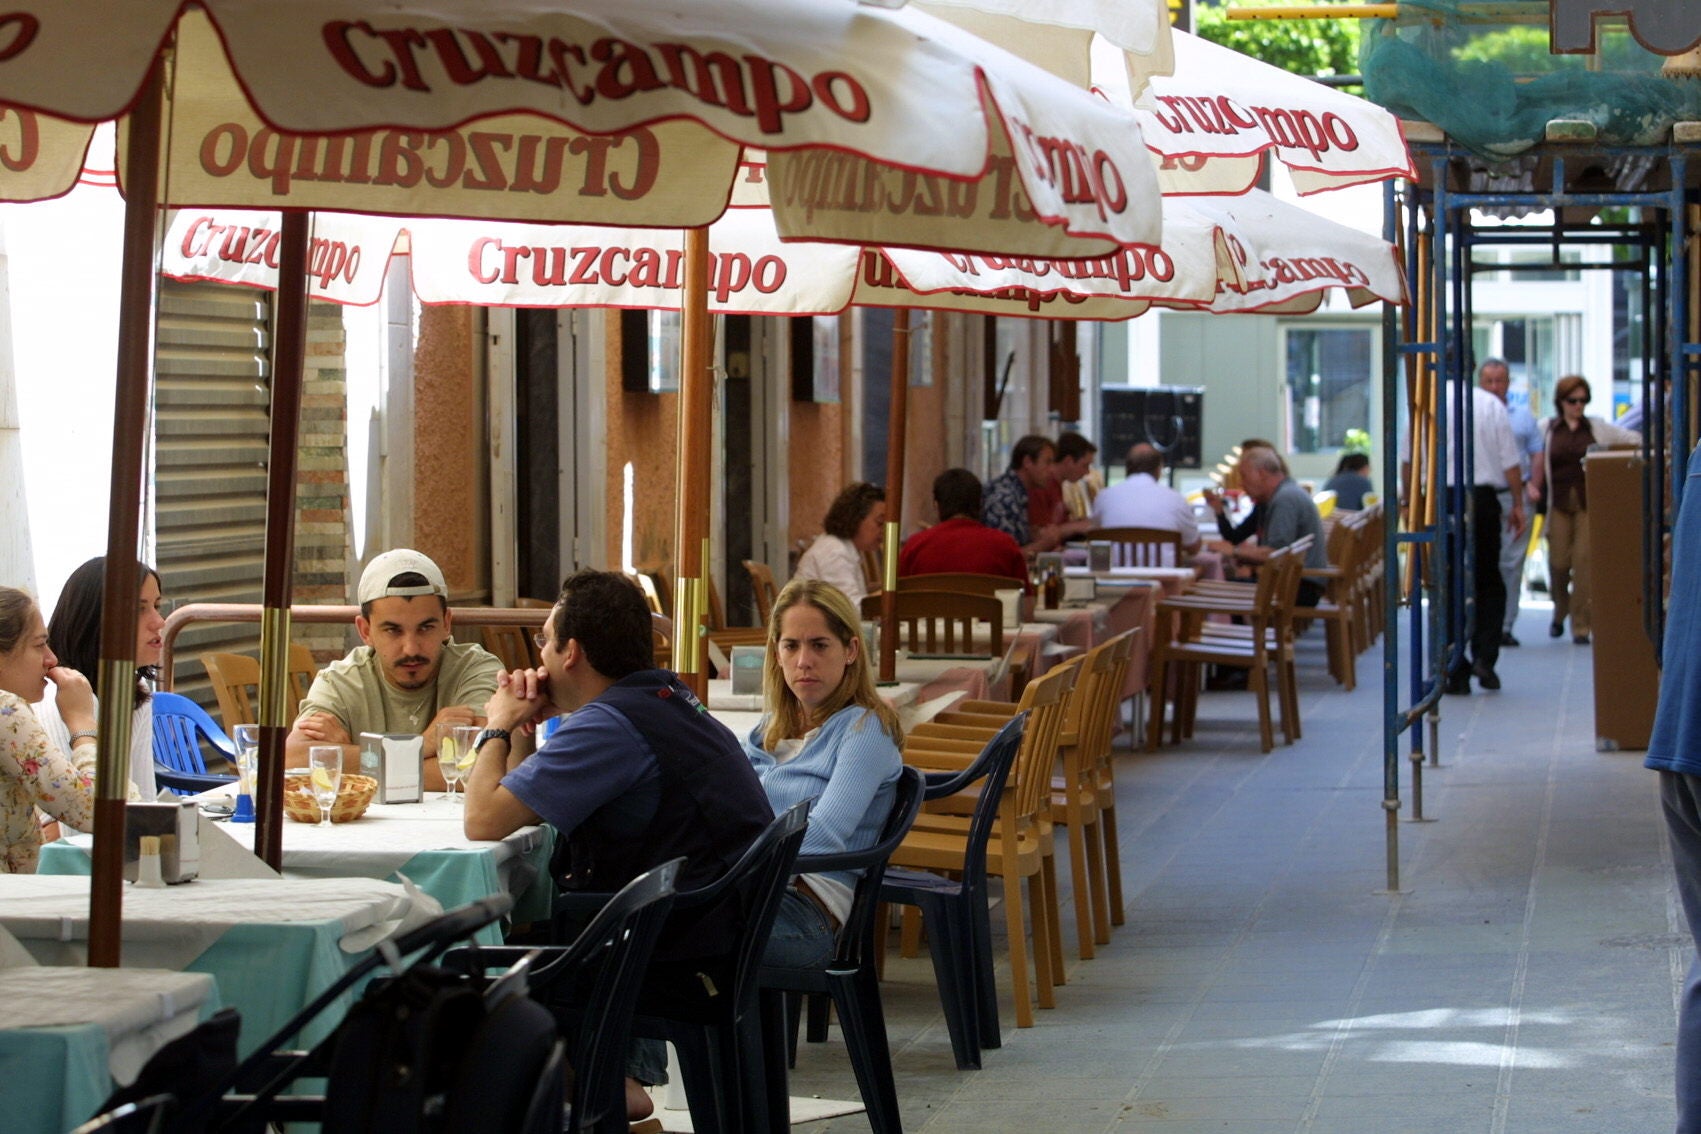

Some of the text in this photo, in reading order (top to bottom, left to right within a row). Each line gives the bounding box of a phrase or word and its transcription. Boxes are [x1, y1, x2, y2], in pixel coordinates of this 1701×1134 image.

[322, 20, 870, 135] Cruzcampo
[180, 216, 361, 289] Cruzcmpo
[468, 236, 787, 303] Cruzcampo
